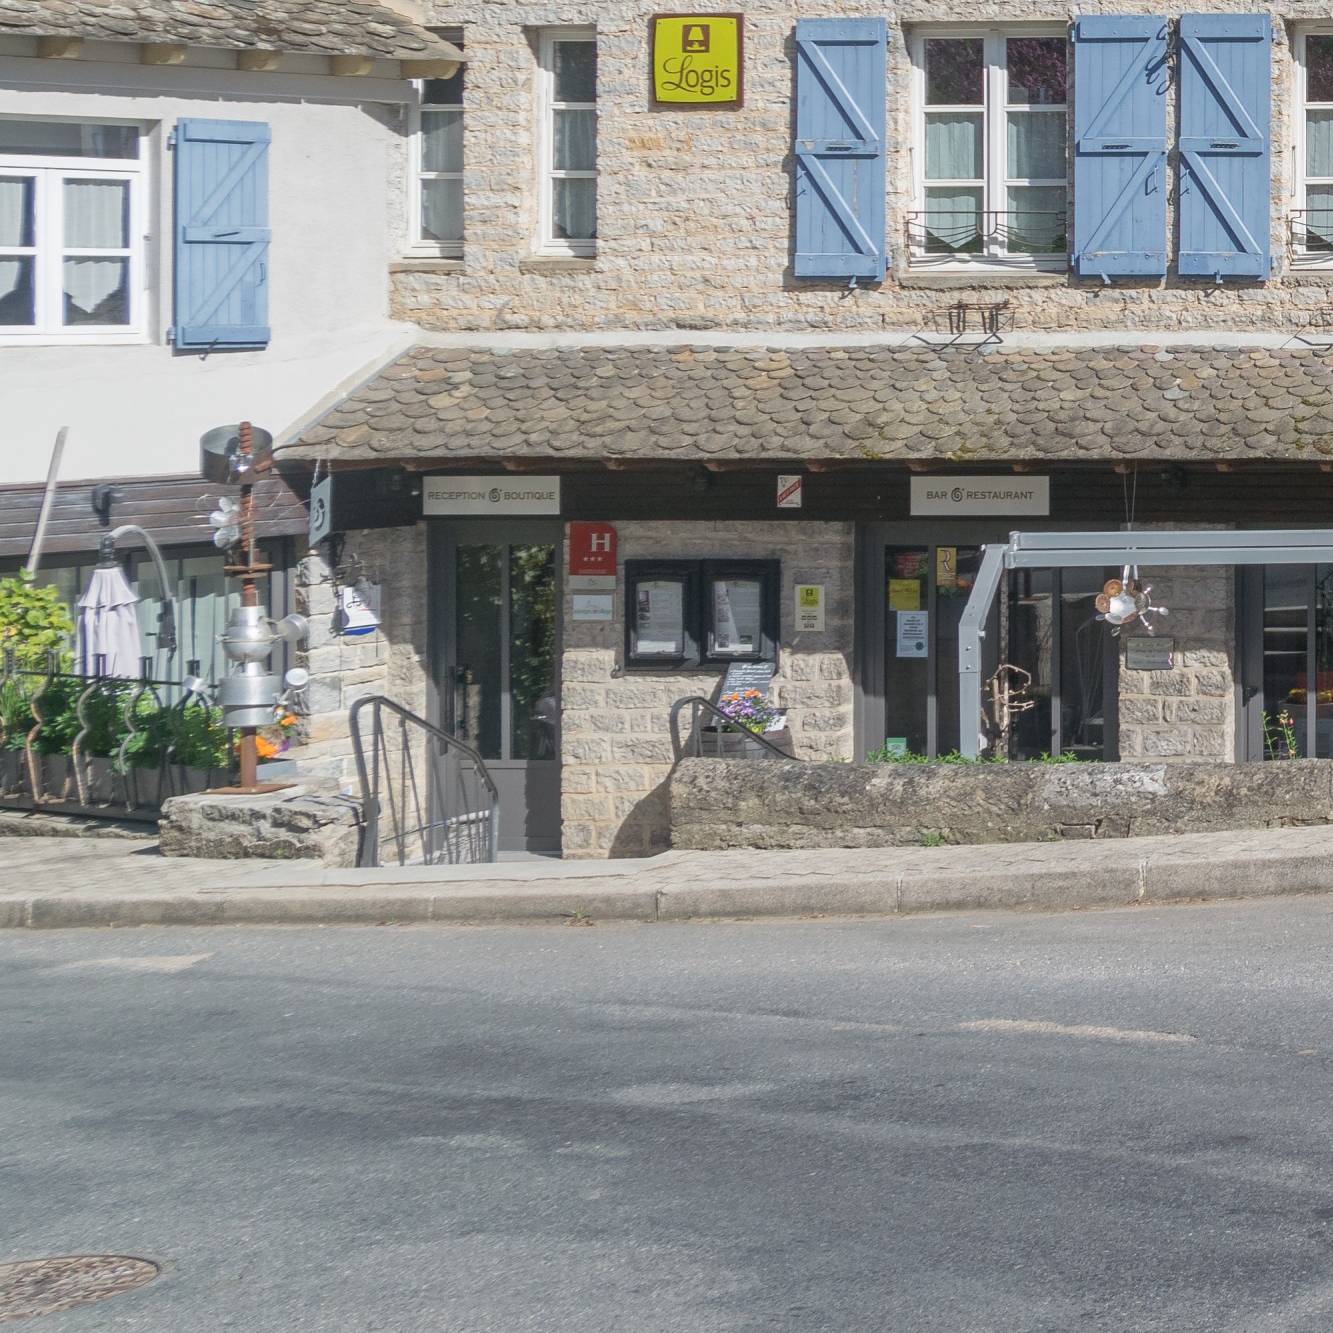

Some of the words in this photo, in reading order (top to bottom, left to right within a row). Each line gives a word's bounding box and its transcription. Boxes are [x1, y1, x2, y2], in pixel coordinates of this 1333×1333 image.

[661, 55, 731, 96] Logis
[427, 491, 486, 500] RECEPTION
[503, 491, 556, 500] BOUTIQUE
[926, 490, 948, 500] BAR
[966, 490, 1035, 500] RESTAURANT
[590, 533, 611, 552] H
